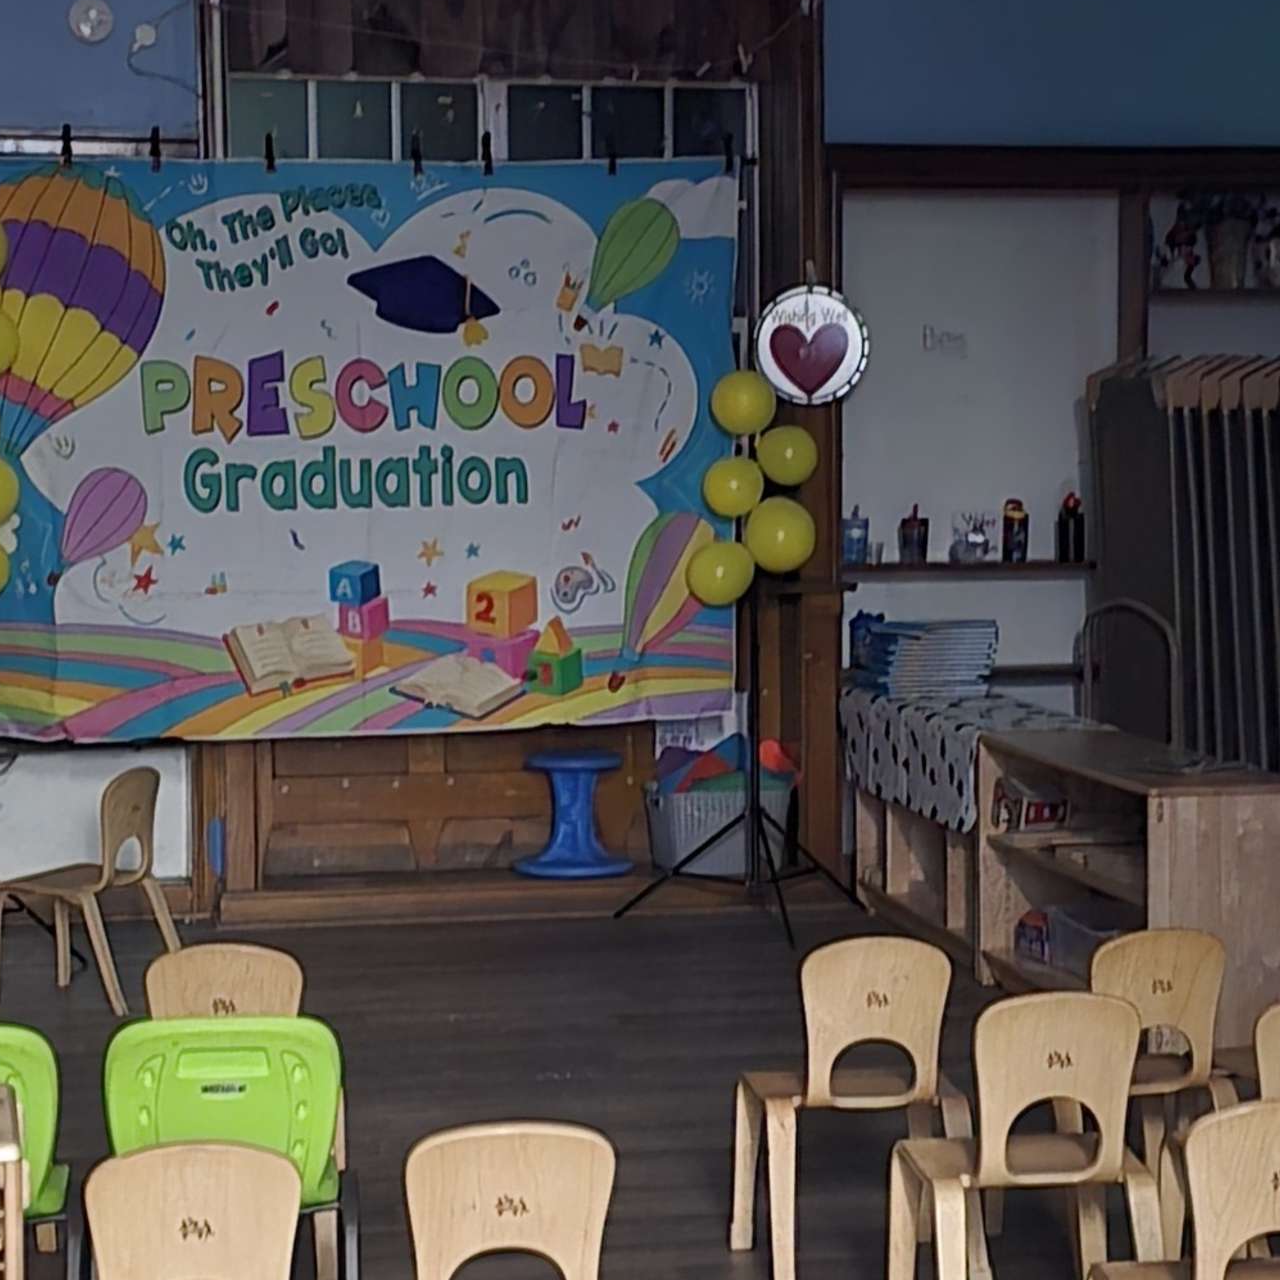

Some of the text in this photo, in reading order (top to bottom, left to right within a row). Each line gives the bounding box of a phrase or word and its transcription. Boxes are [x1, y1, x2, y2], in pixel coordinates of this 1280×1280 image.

[222, 206, 275, 244] The
[278, 183, 382, 221] Places
[195, 228, 349, 292] They'll Go!
[140, 350, 587, 444] PRESCHOOL
[183, 444, 529, 514] Graduation
[335, 577, 354, 599] A
[474, 592, 496, 624] 2
